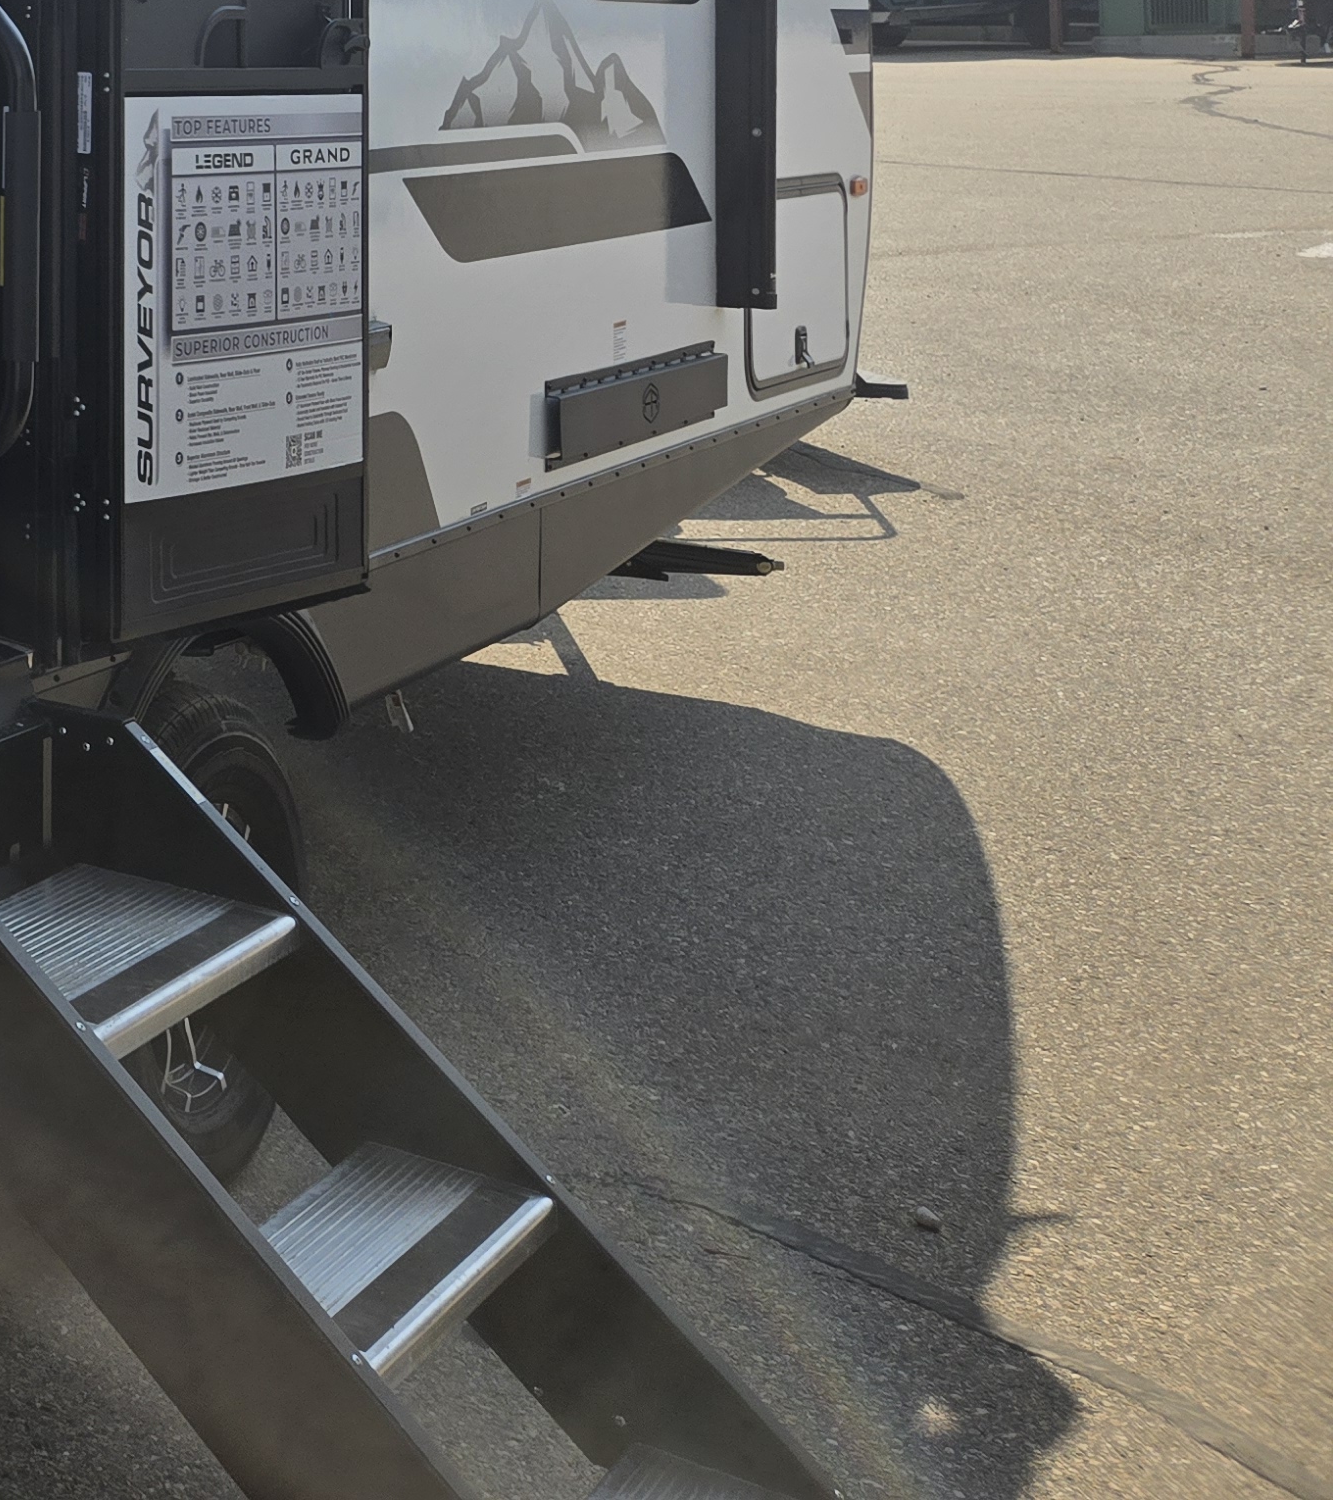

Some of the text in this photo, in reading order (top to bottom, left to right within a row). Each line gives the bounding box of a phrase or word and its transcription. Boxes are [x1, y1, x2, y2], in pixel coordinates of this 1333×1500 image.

[173, 118, 271, 136] TOP FEATURES
[195, 152, 254, 170] LEGEND
[290, 147, 350, 165] GRAND
[137, 192, 154, 485] SURVEYOR
[175, 325, 329, 357] SUPERIOR CONSTRUCTION
